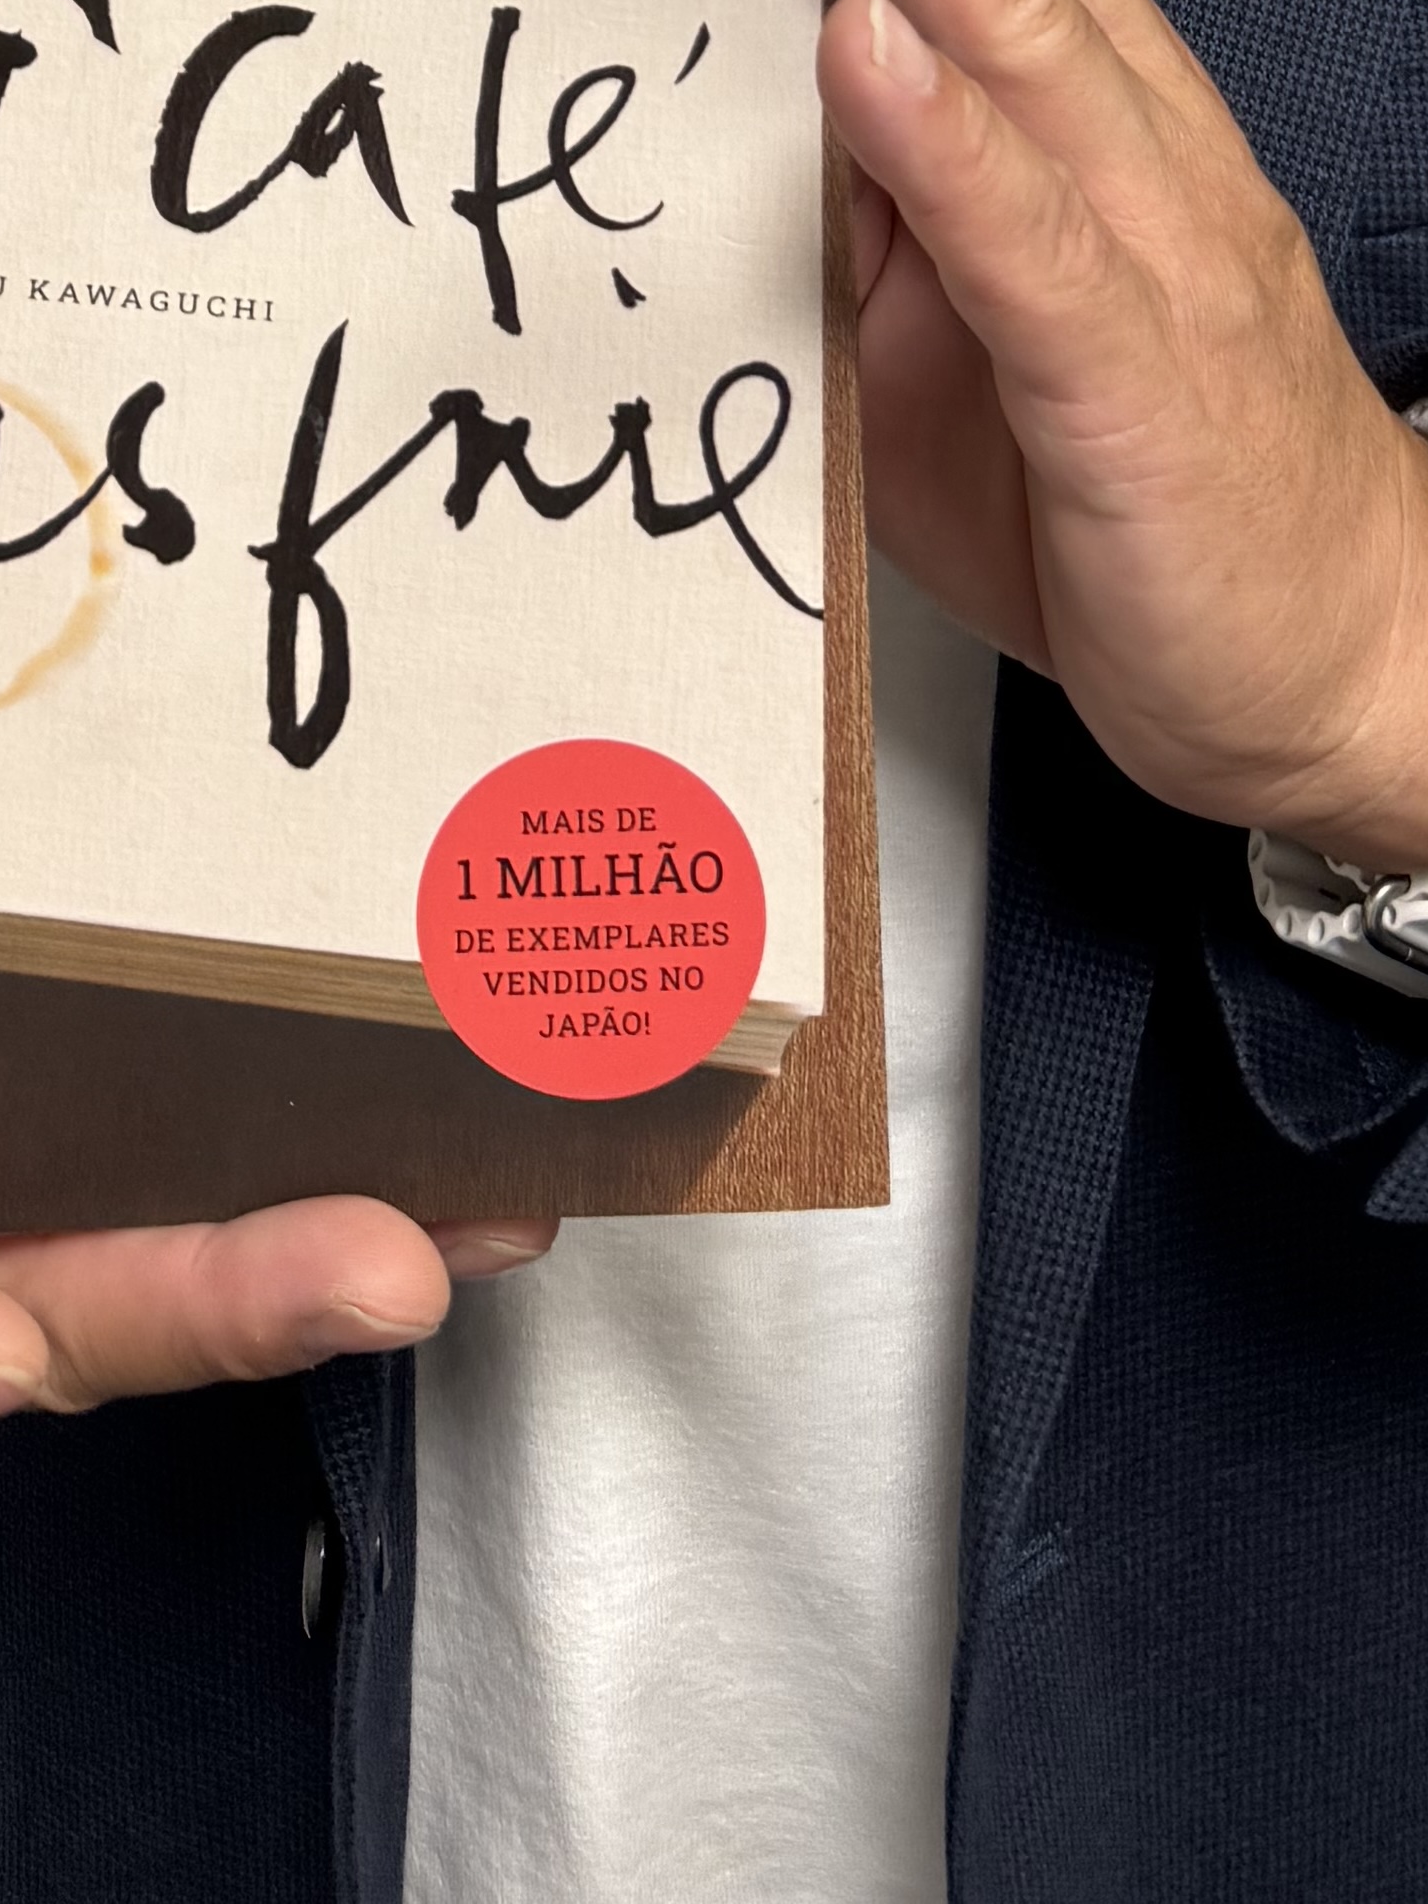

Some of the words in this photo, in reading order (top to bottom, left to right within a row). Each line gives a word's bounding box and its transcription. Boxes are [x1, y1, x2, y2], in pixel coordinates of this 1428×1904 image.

[27, 277, 276, 324] KAWAGUCHI
[520, 808, 606, 836] MAIS
[616, 806, 658, 833] DE
[457, 858, 478, 901] 1
[495, 840, 725, 900] MILHÃO
[454, 928, 496, 954] DE
[506, 921, 731, 953] EXEMPLARES
[482, 967, 649, 997] VENDIDOS
[659, 965, 705, 992] NO
[537, 1005, 652, 1039] JAPÃO!
